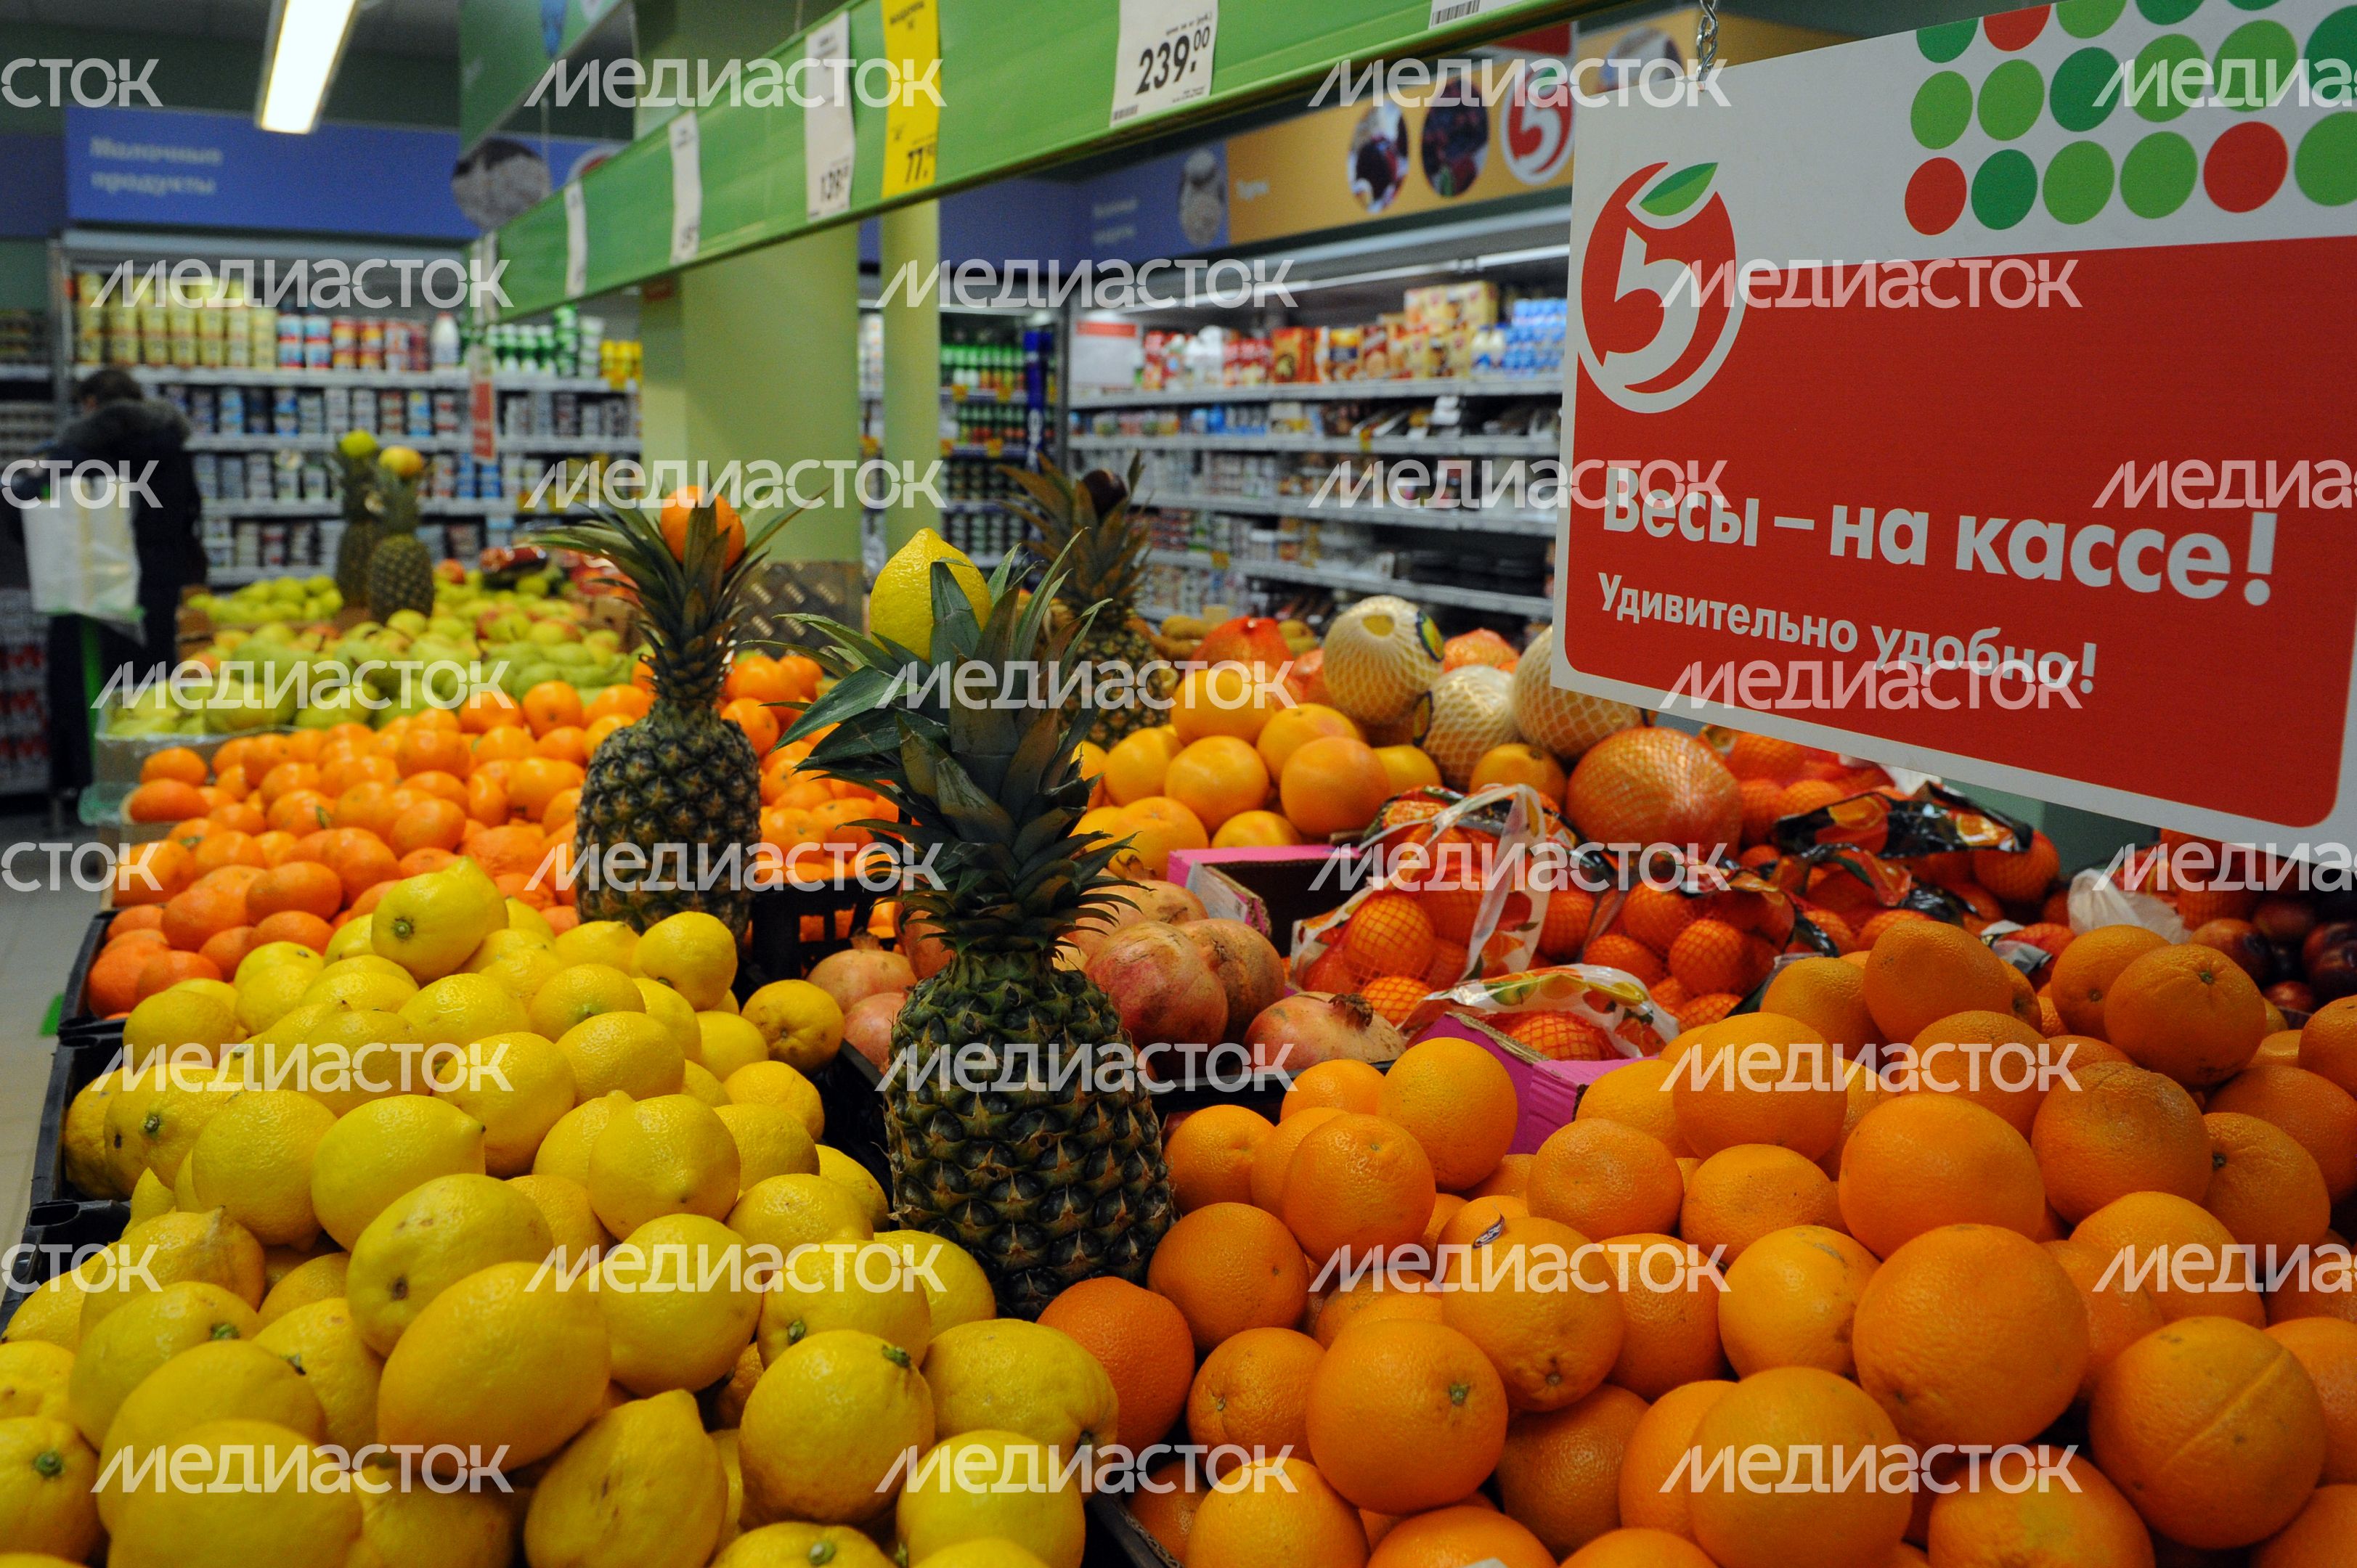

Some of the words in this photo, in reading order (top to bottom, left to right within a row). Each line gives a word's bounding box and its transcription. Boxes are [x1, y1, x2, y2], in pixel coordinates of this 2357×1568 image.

[1603, 466, 1759, 547] Весы
[1830, 505, 1929, 566] на
[1955, 512, 2278, 606] кассе!
[1598, 571, 1858, 653] Удивительно
[1871, 624, 2097, 694] удобно!
